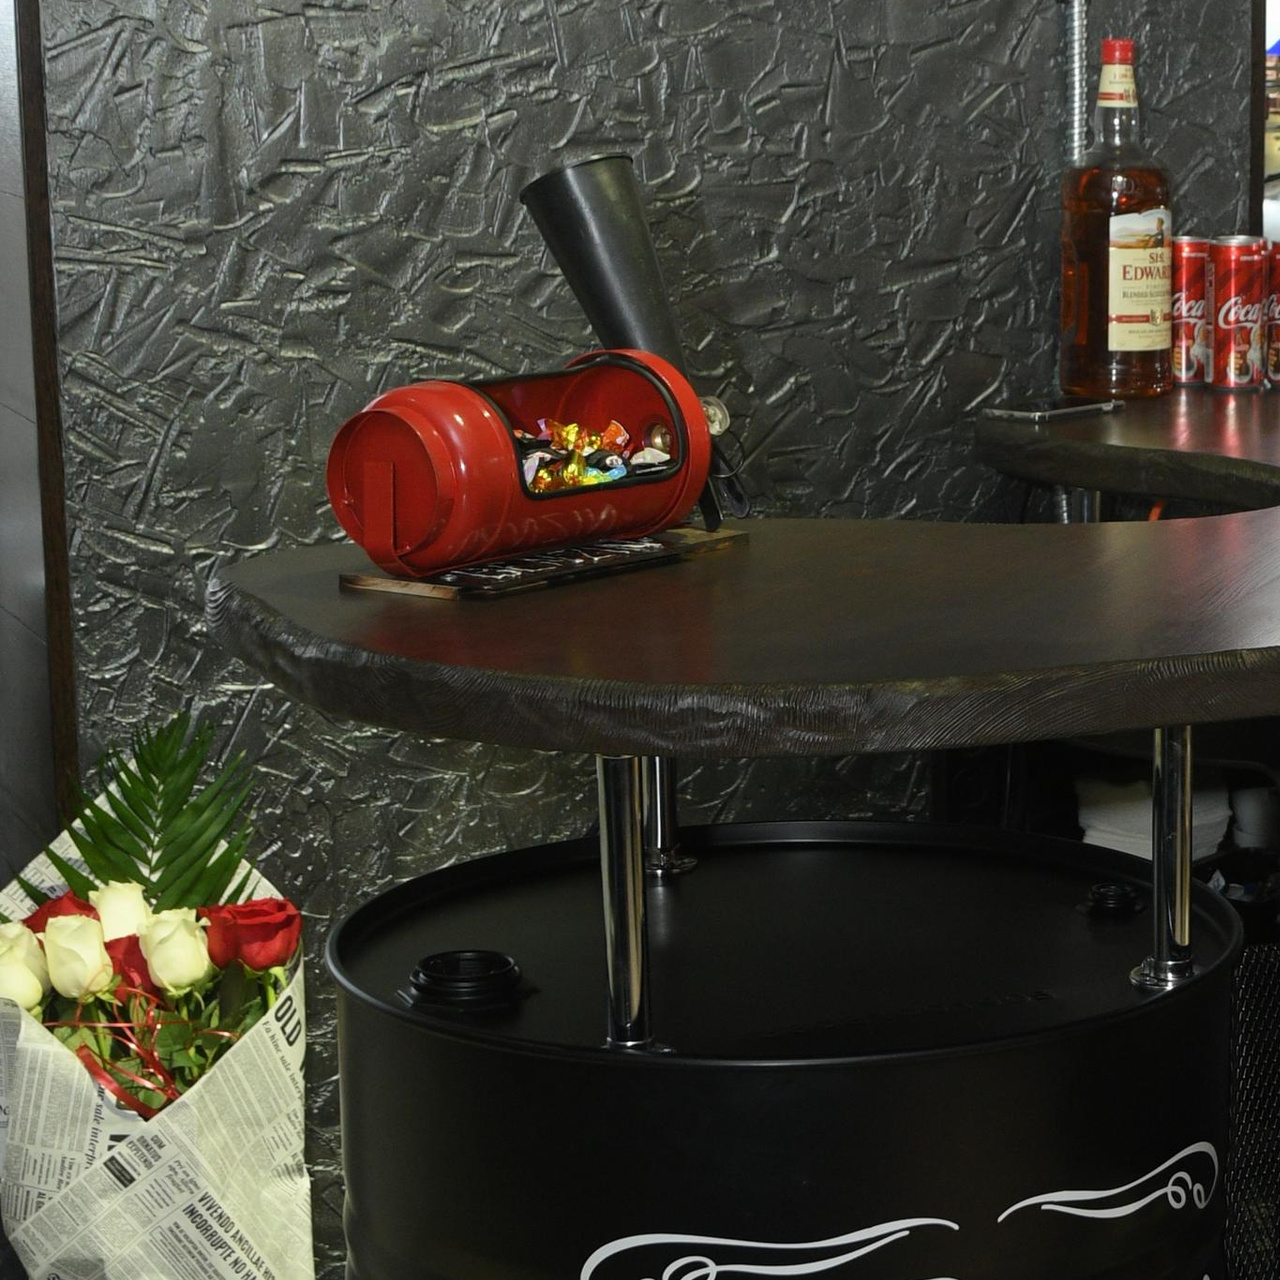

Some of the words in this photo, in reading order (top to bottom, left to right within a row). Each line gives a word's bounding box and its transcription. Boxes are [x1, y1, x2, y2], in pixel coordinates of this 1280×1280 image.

[274, 995, 302, 1047] OLD
[94, 1104, 105, 1125] sale
[182, 1203, 237, 1262] INCORRUPTE
[228, 1256, 247, 1275] NO
[197, 1191, 236, 1234] VIVENDO
[230, 1229, 265, 1272] ANCILLAE
